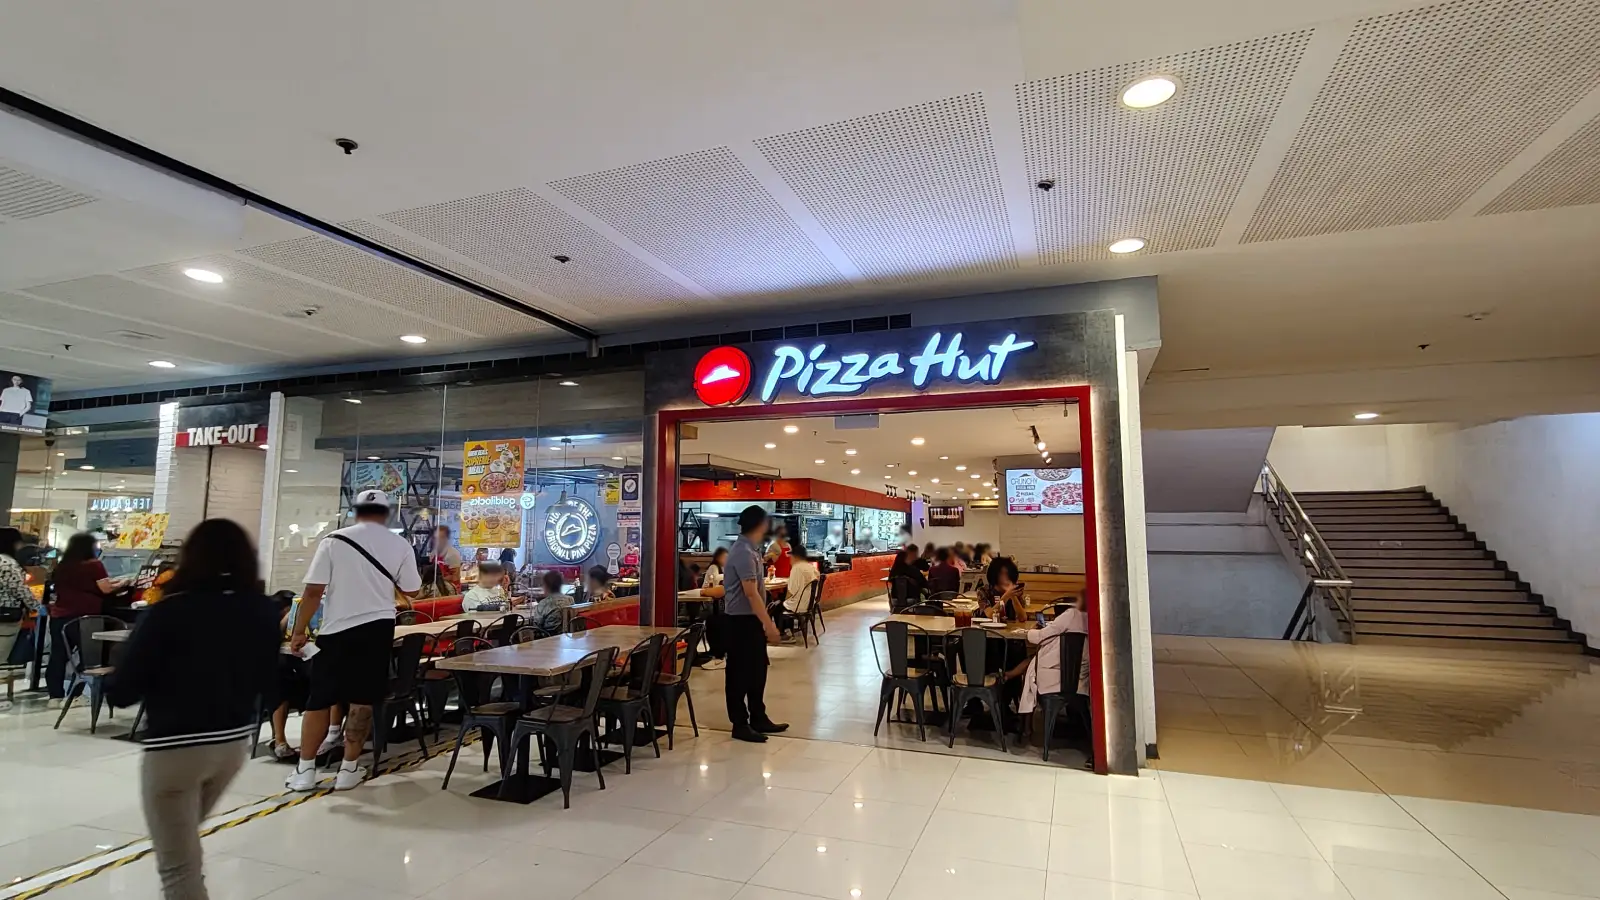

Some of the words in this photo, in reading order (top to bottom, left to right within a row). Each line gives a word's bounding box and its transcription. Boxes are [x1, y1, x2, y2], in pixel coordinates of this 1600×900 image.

[762, 343, 904, 402] Pizza
[909, 332, 1035, 386] Hut
[187, 424, 258, 446] TAKE-OUT
[578, 502, 593, 521] THE
[546, 530, 571, 561] ORIGINAL
[571, 545, 587, 560] PAN
[583, 523, 597, 550] PIZZA
